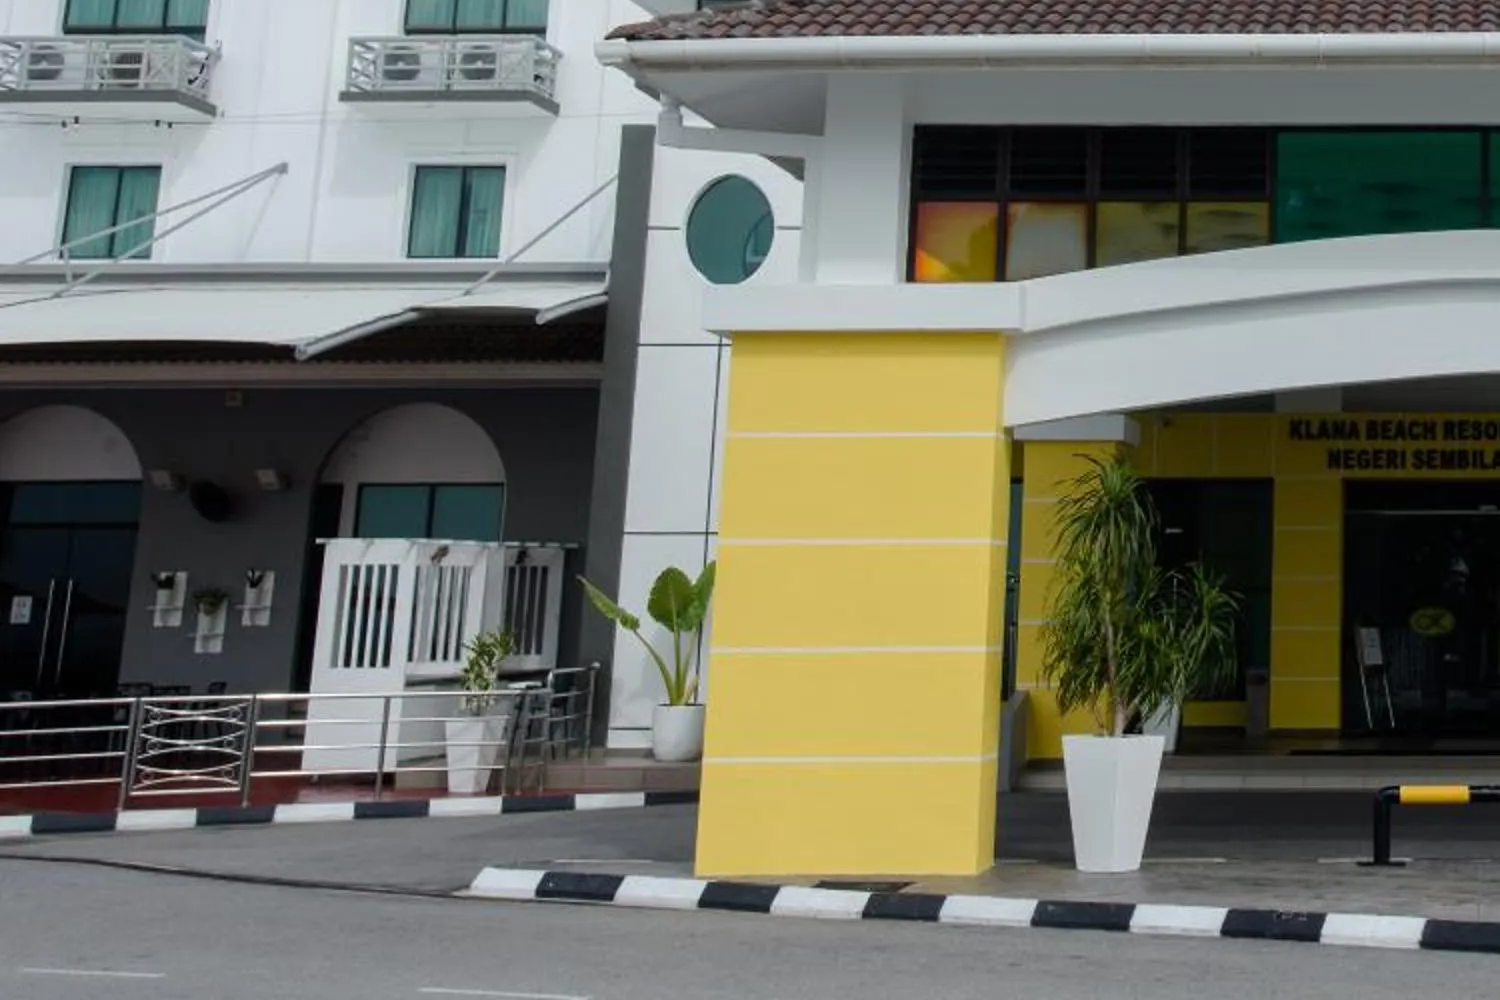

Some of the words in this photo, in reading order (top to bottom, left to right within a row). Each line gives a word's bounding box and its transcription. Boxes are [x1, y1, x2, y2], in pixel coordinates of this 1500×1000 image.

[1290, 419, 1360, 440] KLANA
[1365, 419, 1437, 440] BEACH
[1328, 449, 1406, 470] NEGERI
